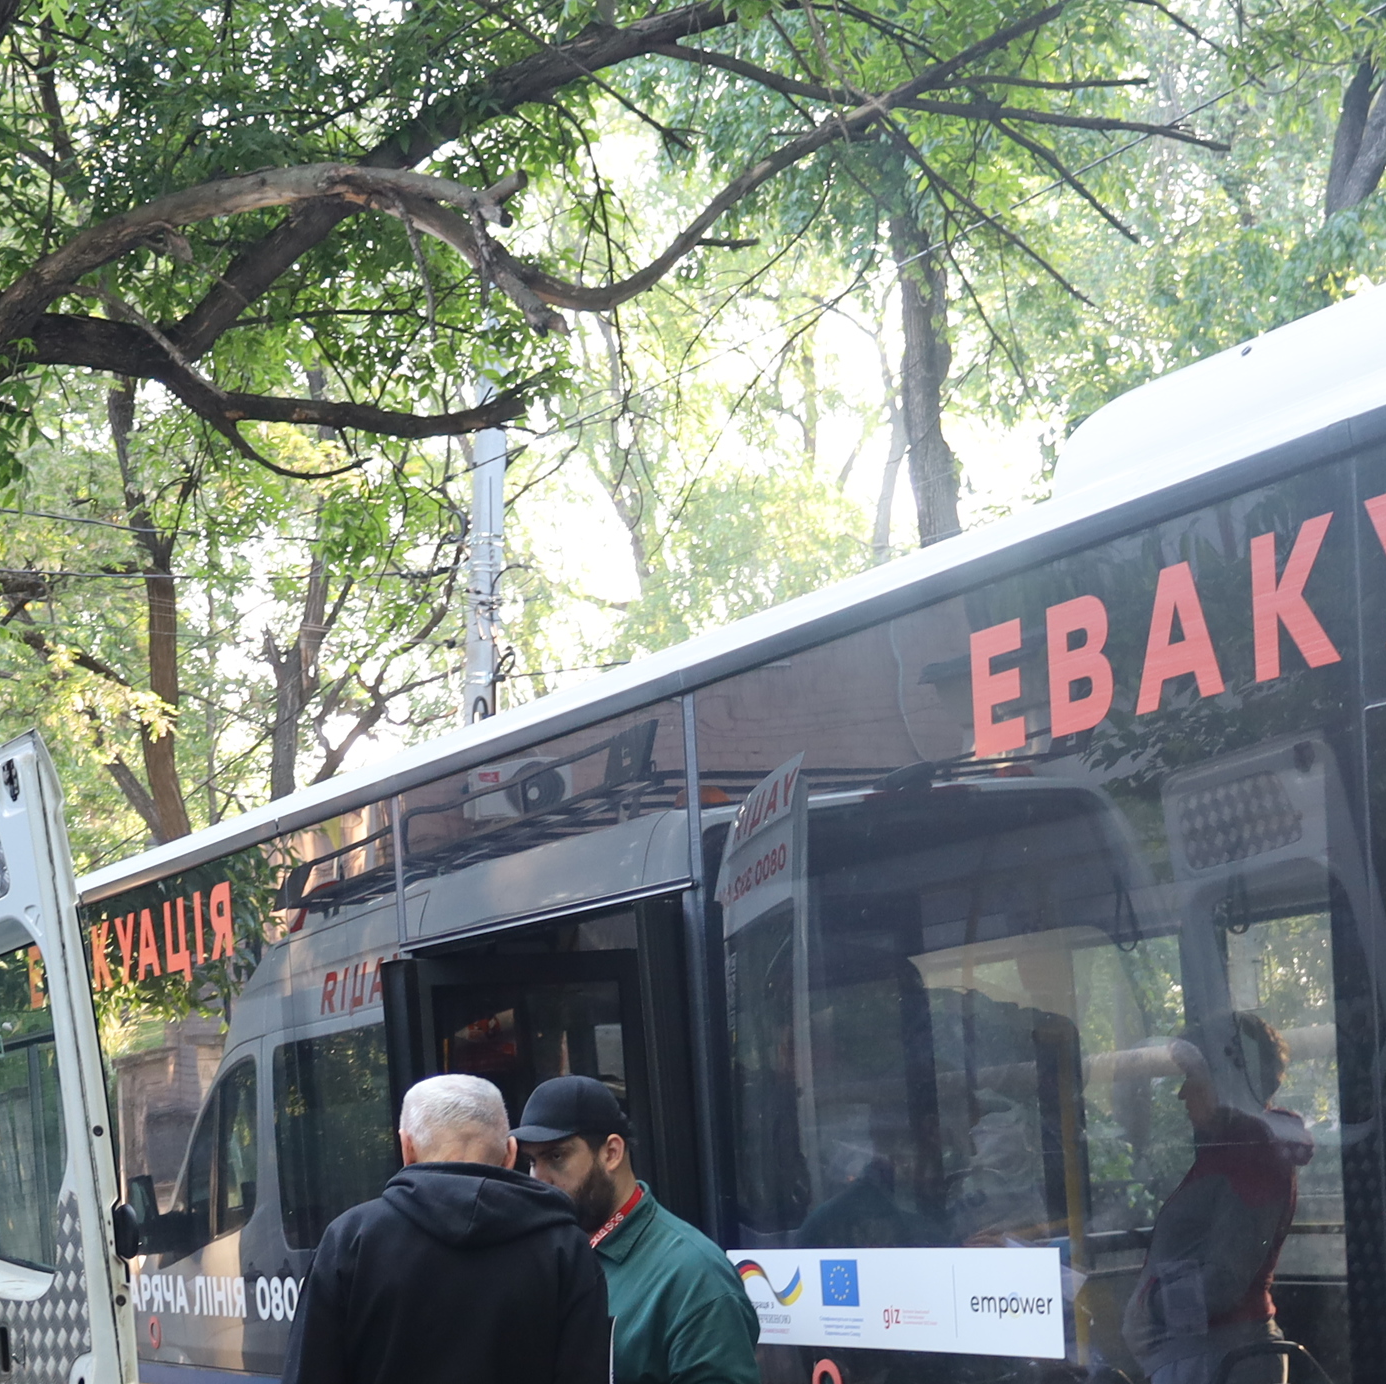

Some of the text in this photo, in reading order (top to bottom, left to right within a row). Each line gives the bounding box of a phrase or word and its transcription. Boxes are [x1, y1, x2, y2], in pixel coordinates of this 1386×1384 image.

[129, 1273, 306, 1323] АРЯЧА ЛІНІЯ 080
[969, 1294, 1053, 1320] empower
[882, 1305, 901, 1329] giz
